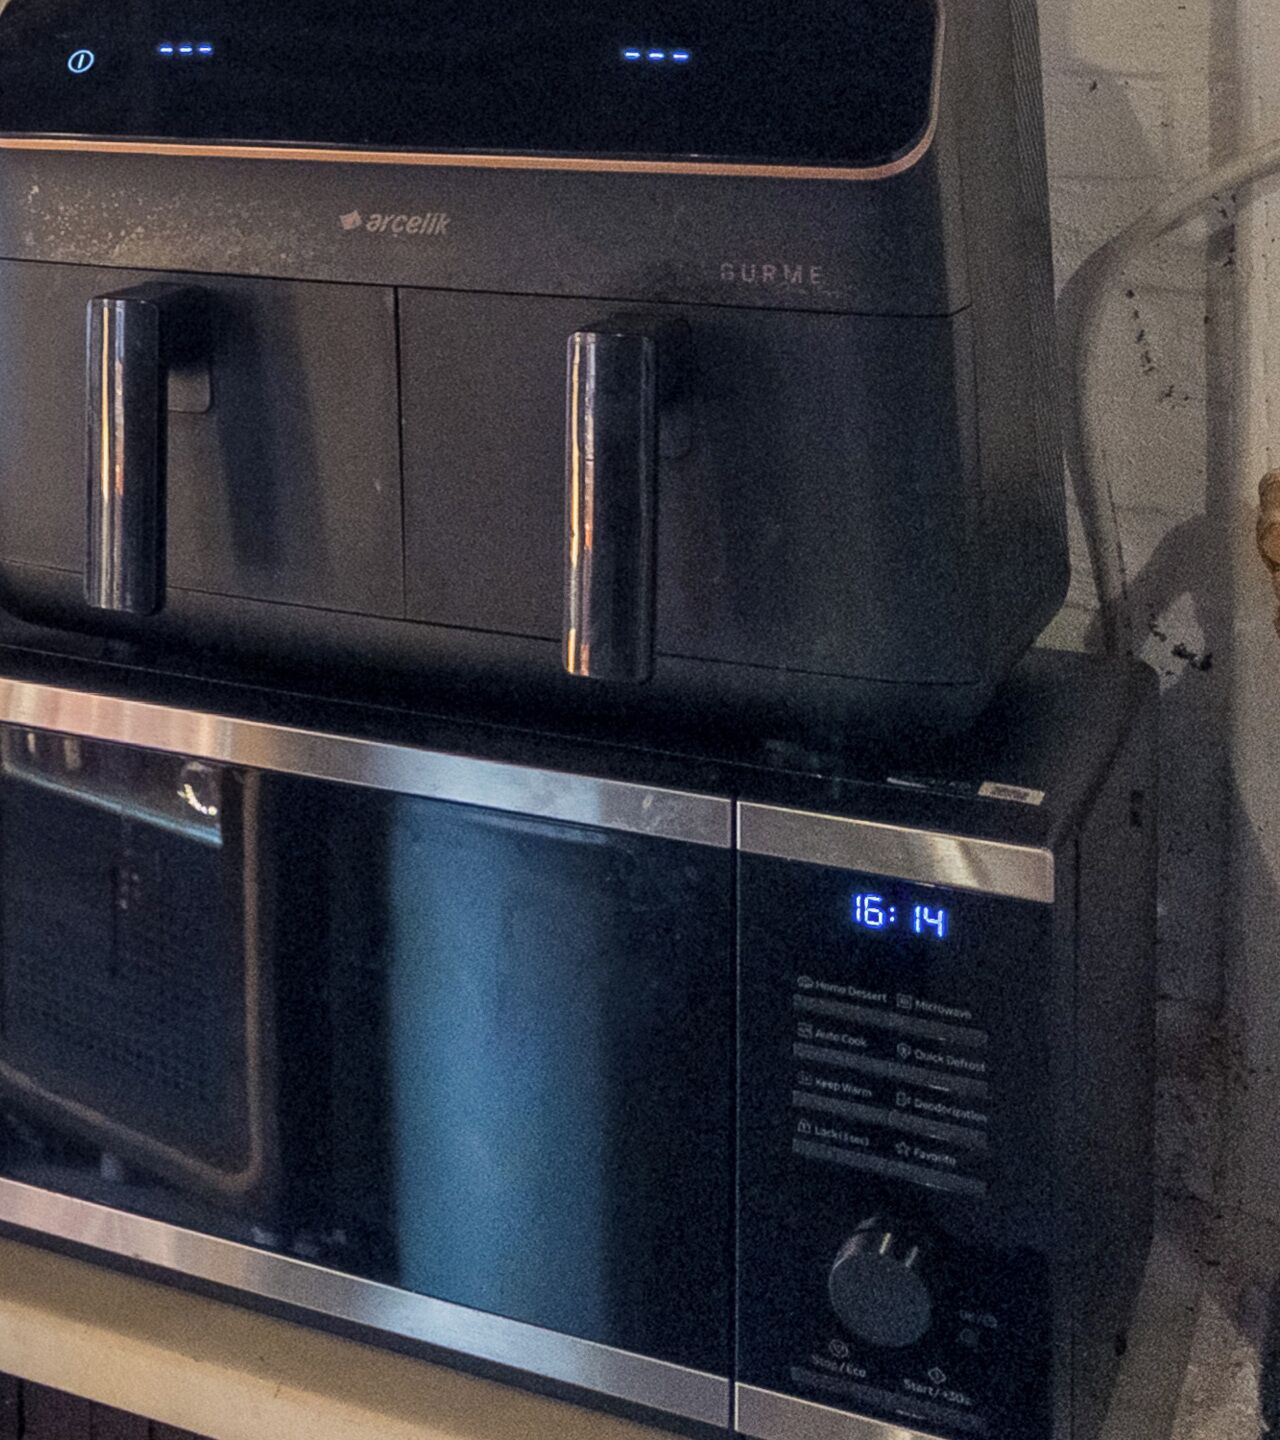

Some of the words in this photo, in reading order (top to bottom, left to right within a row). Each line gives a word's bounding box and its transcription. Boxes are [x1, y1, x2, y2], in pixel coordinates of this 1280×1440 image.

[366, 212, 451, 238] arçelik
[721, 263, 821, 284] GURME
[848, 985, 888, 1003] Dessert
[841, 1033, 867, 1048] Cook
[946, 1055, 986, 1072] Defrost
